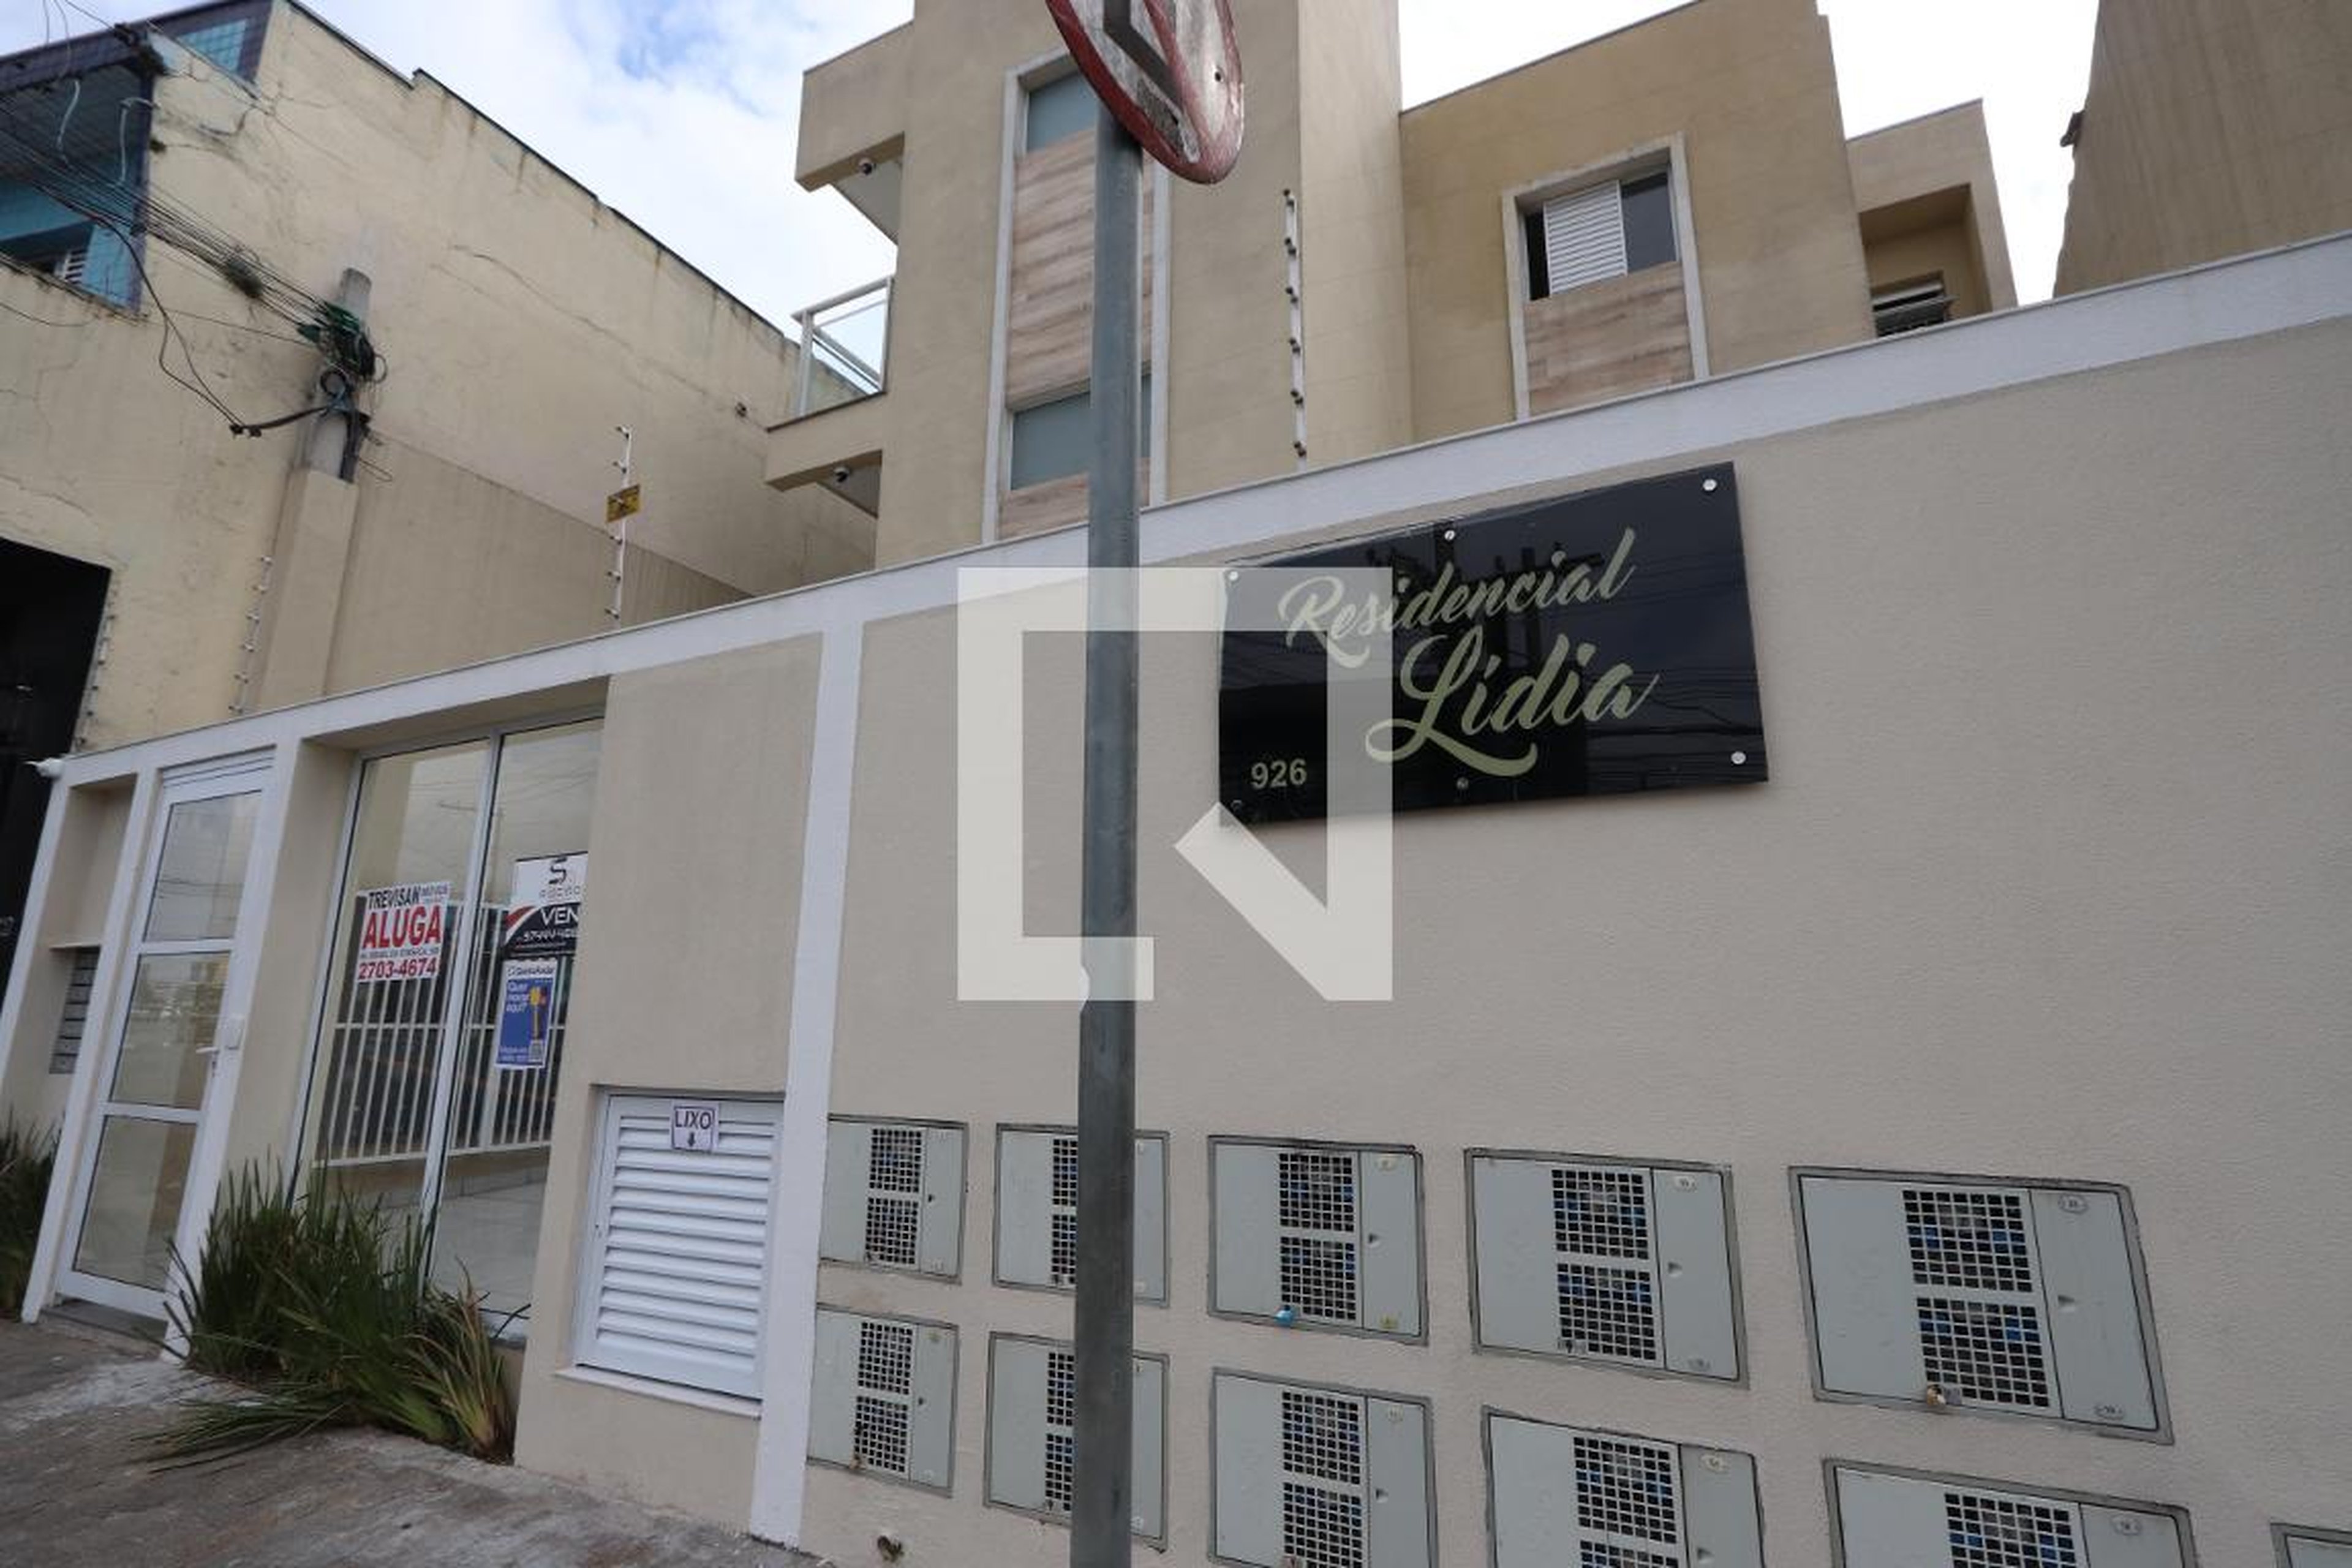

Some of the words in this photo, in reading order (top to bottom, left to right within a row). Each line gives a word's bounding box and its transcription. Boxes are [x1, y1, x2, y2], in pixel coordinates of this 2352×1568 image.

[1278, 527, 1635, 668] Residencial
[1251, 759, 1307, 789] 926
[369, 886, 421, 910] TREVISAN
[363, 905, 441, 949] ALUGA
[358, 957, 437, 979] 2703-4674
[675, 1110, 711, 1130] LIXO
